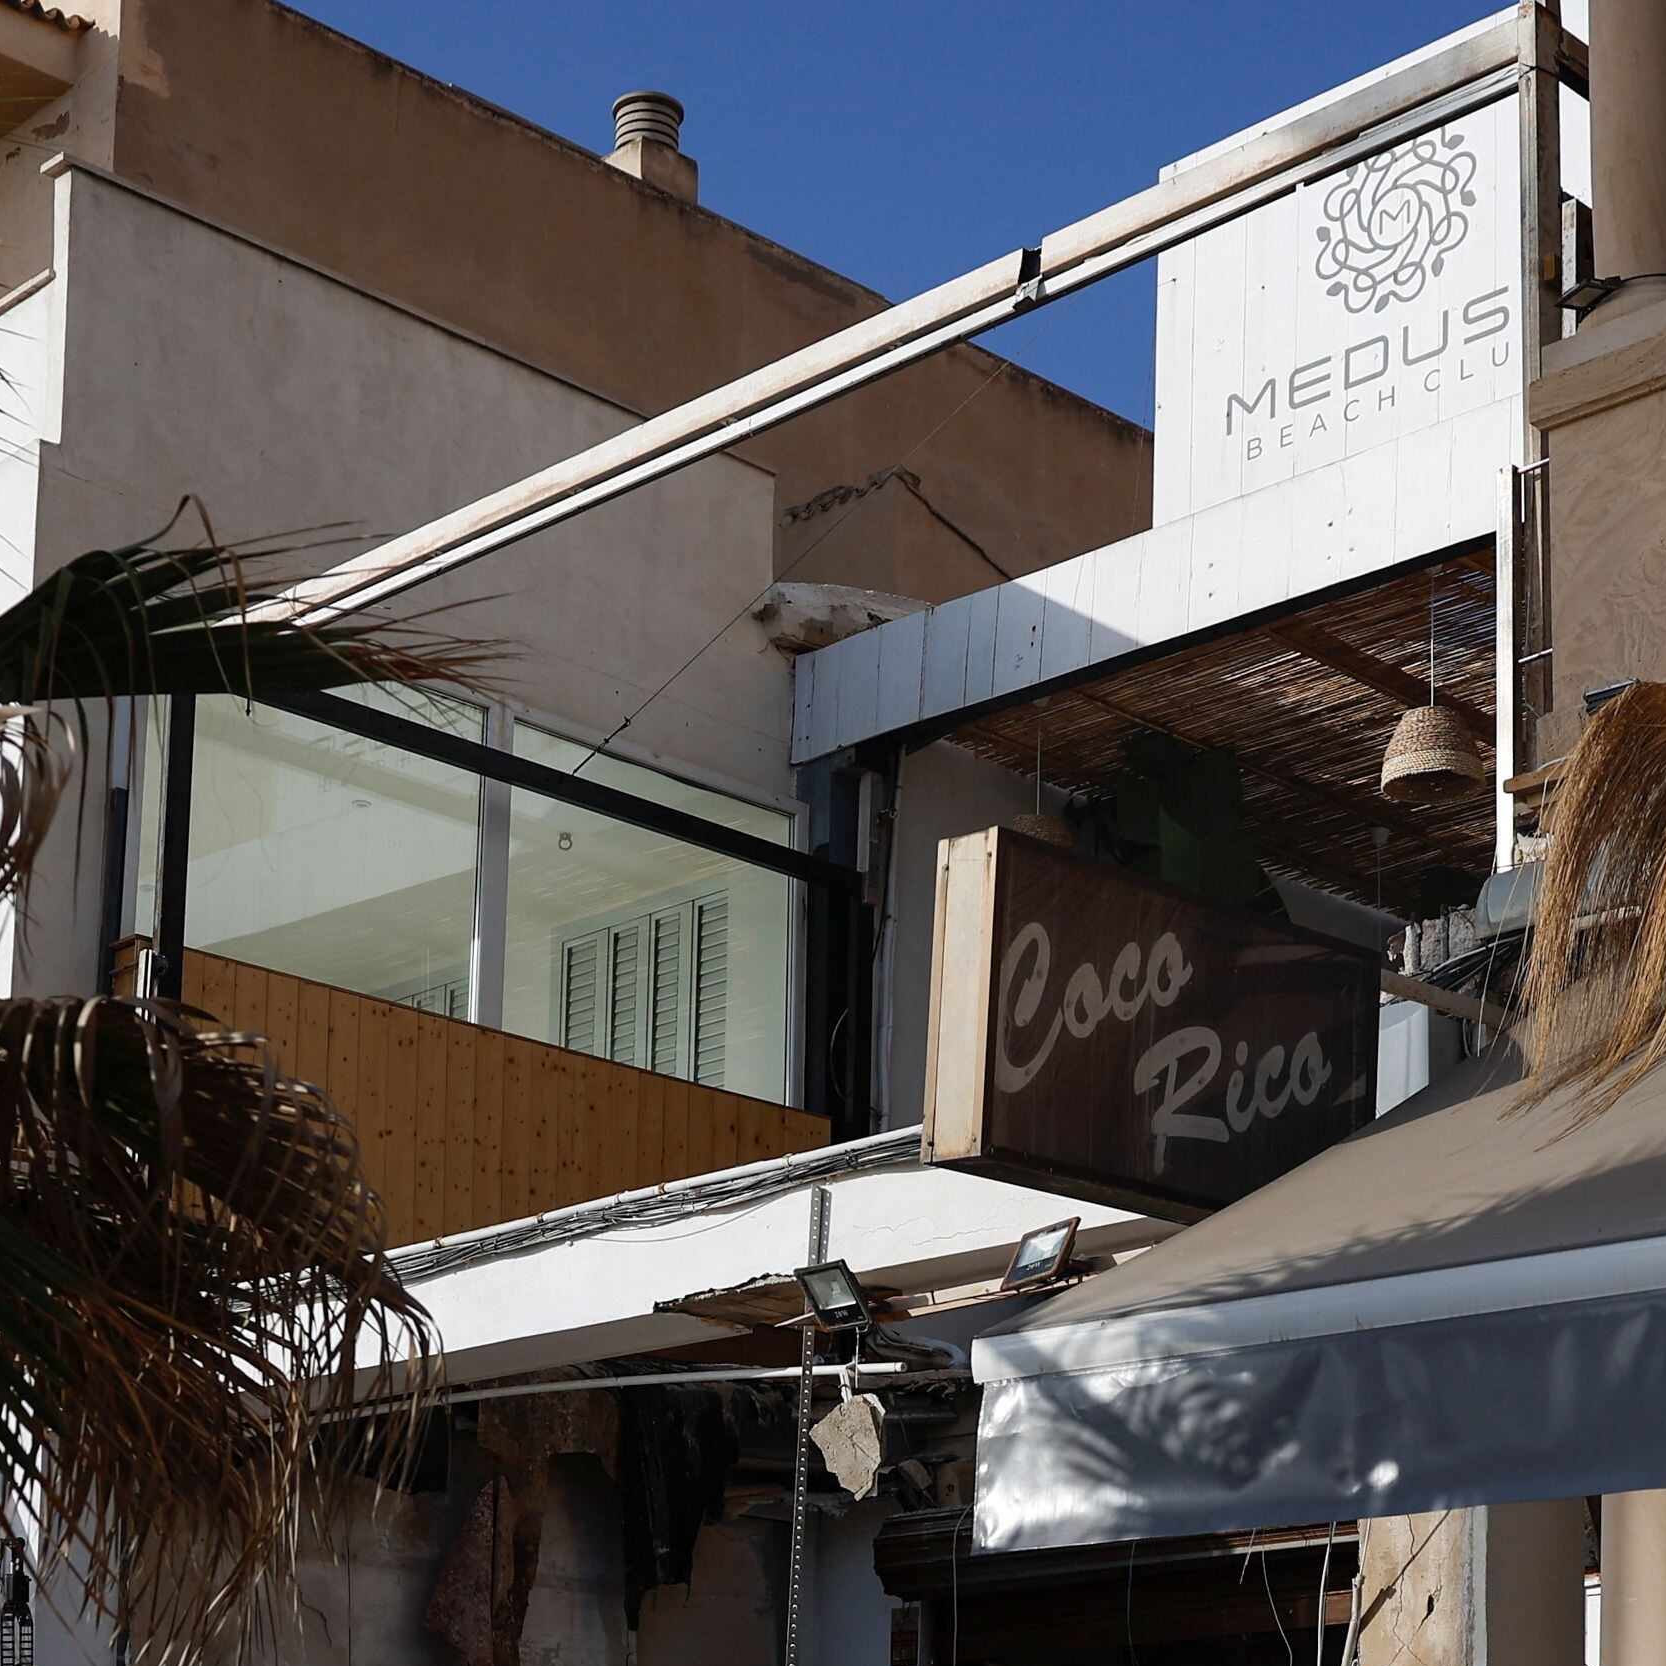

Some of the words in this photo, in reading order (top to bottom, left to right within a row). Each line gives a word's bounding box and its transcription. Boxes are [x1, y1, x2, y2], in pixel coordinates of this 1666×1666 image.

[1226, 285, 1510, 437] MEDUS
[1246, 384, 1396, 461] BEACH
[1423, 342, 1510, 392] CLU
[994, 922, 1194, 1093] Coco
[1134, 1026, 1332, 1176] Rico
